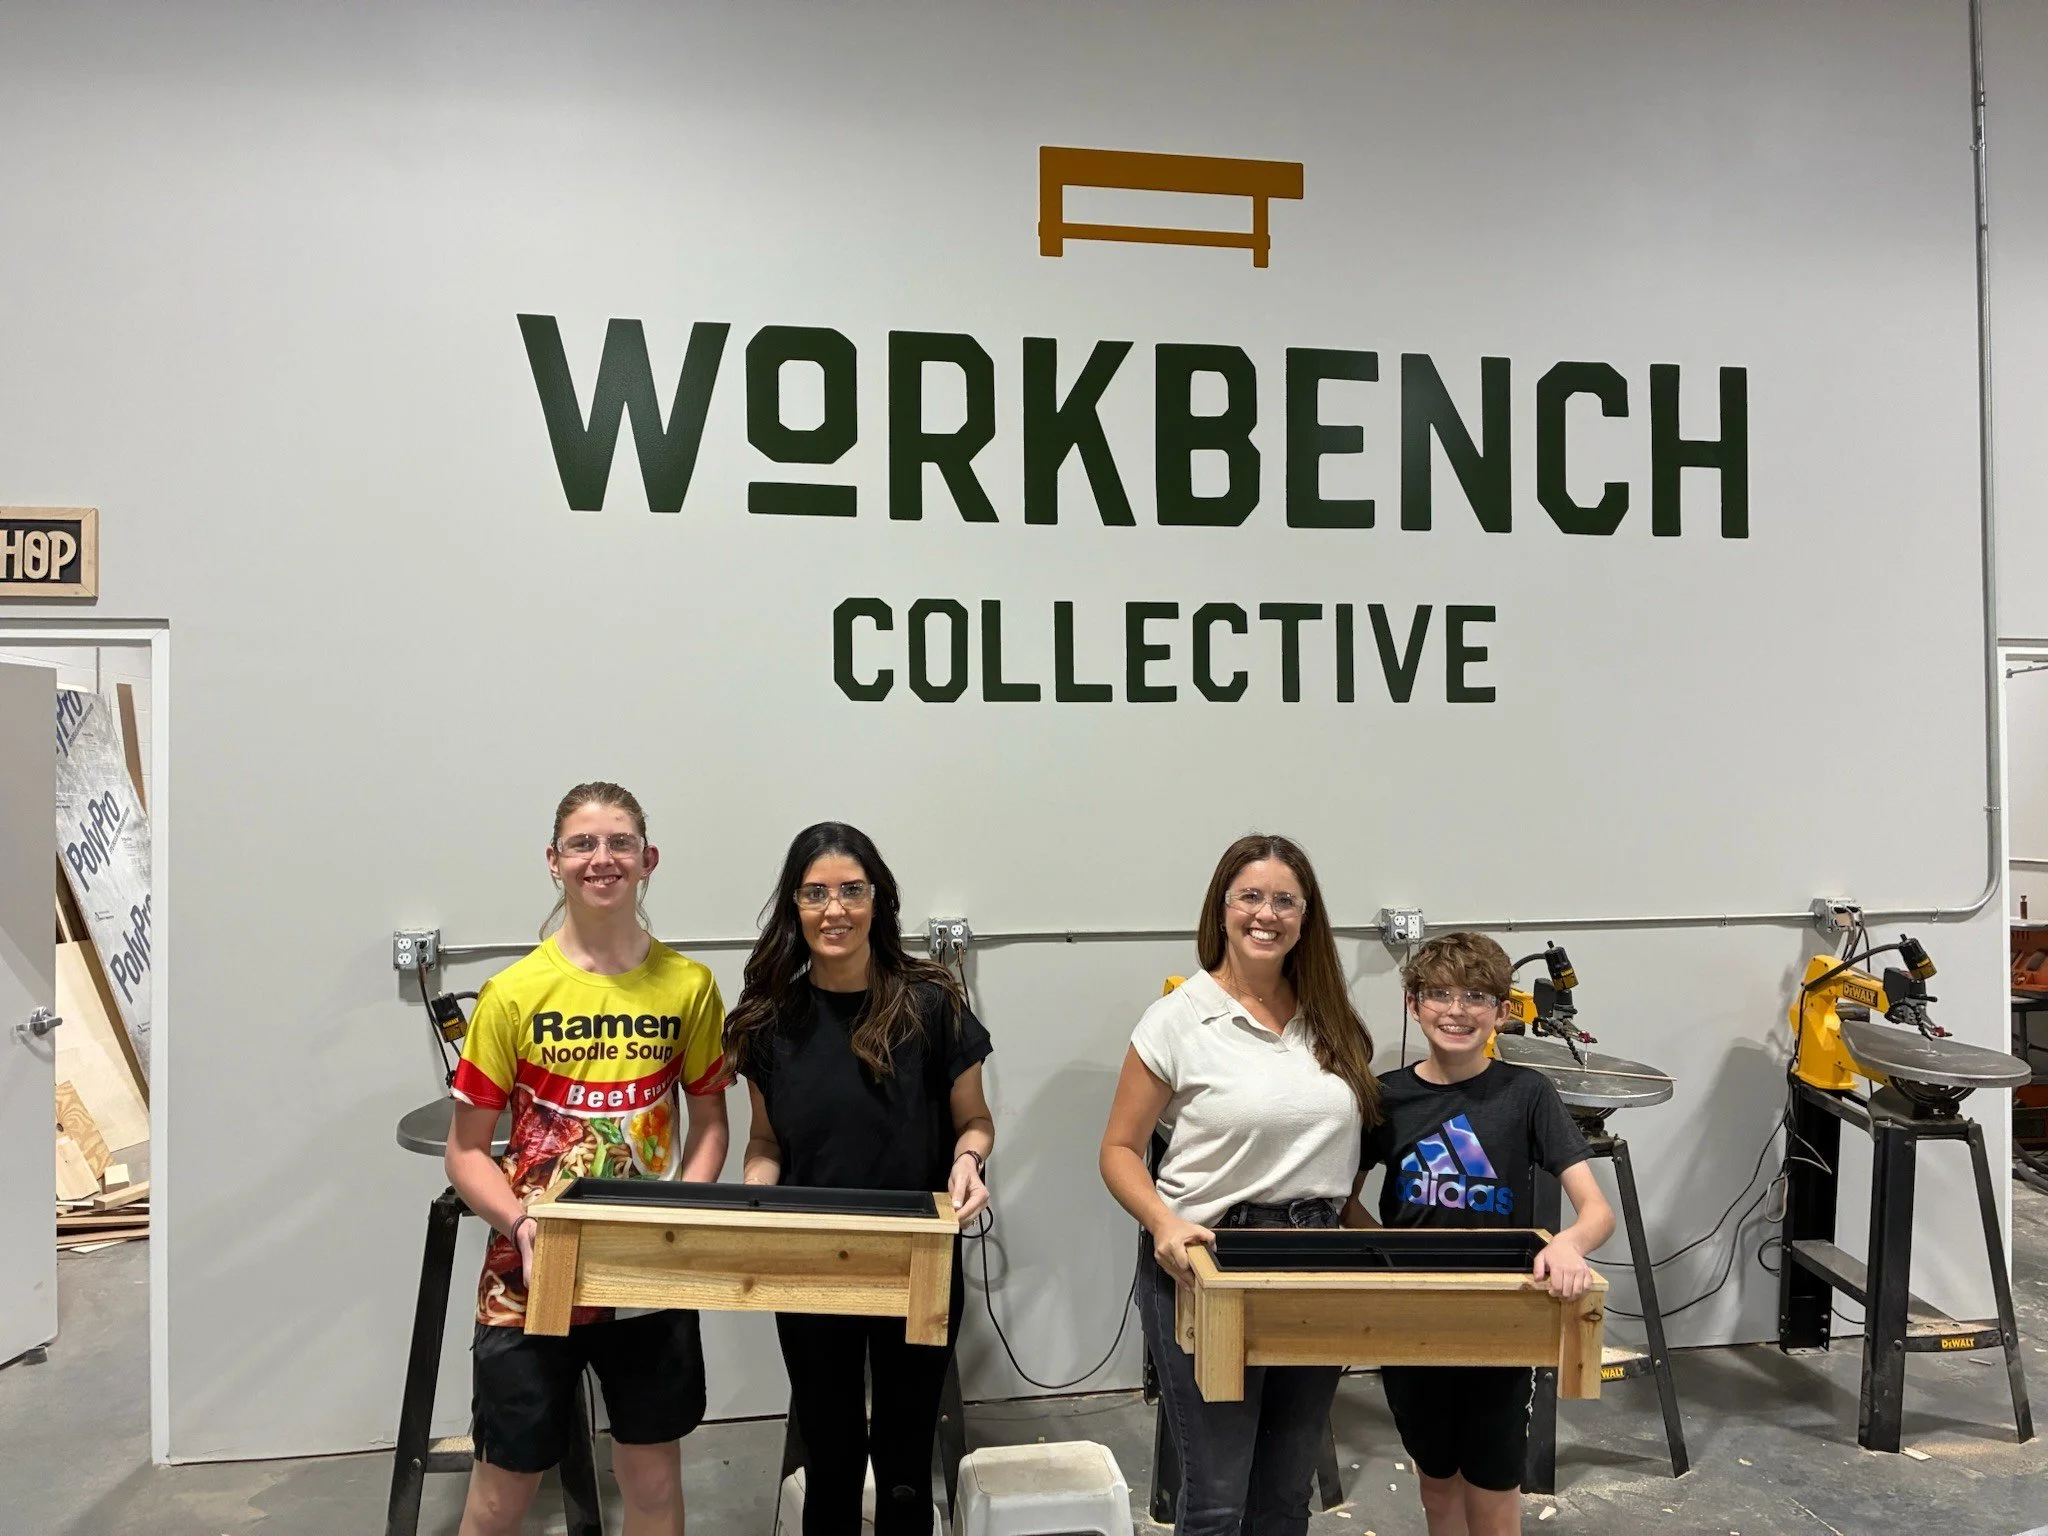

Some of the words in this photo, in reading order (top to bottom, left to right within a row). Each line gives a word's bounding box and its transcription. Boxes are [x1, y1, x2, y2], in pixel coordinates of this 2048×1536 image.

[516, 313, 1748, 538] WORKBENCH
[833, 597, 1496, 703] COLLECTIVE
[66, 790, 121, 893] PolyPro
[532, 1011, 682, 1045] Ramen
[541, 1042, 619, 1065] Noodle
[625, 1041, 673, 1063] Soup
[566, 1082, 637, 1108] Beef
[1396, 1171, 1514, 1215] adidas
[1601, 1366, 1625, 1379] WALT
